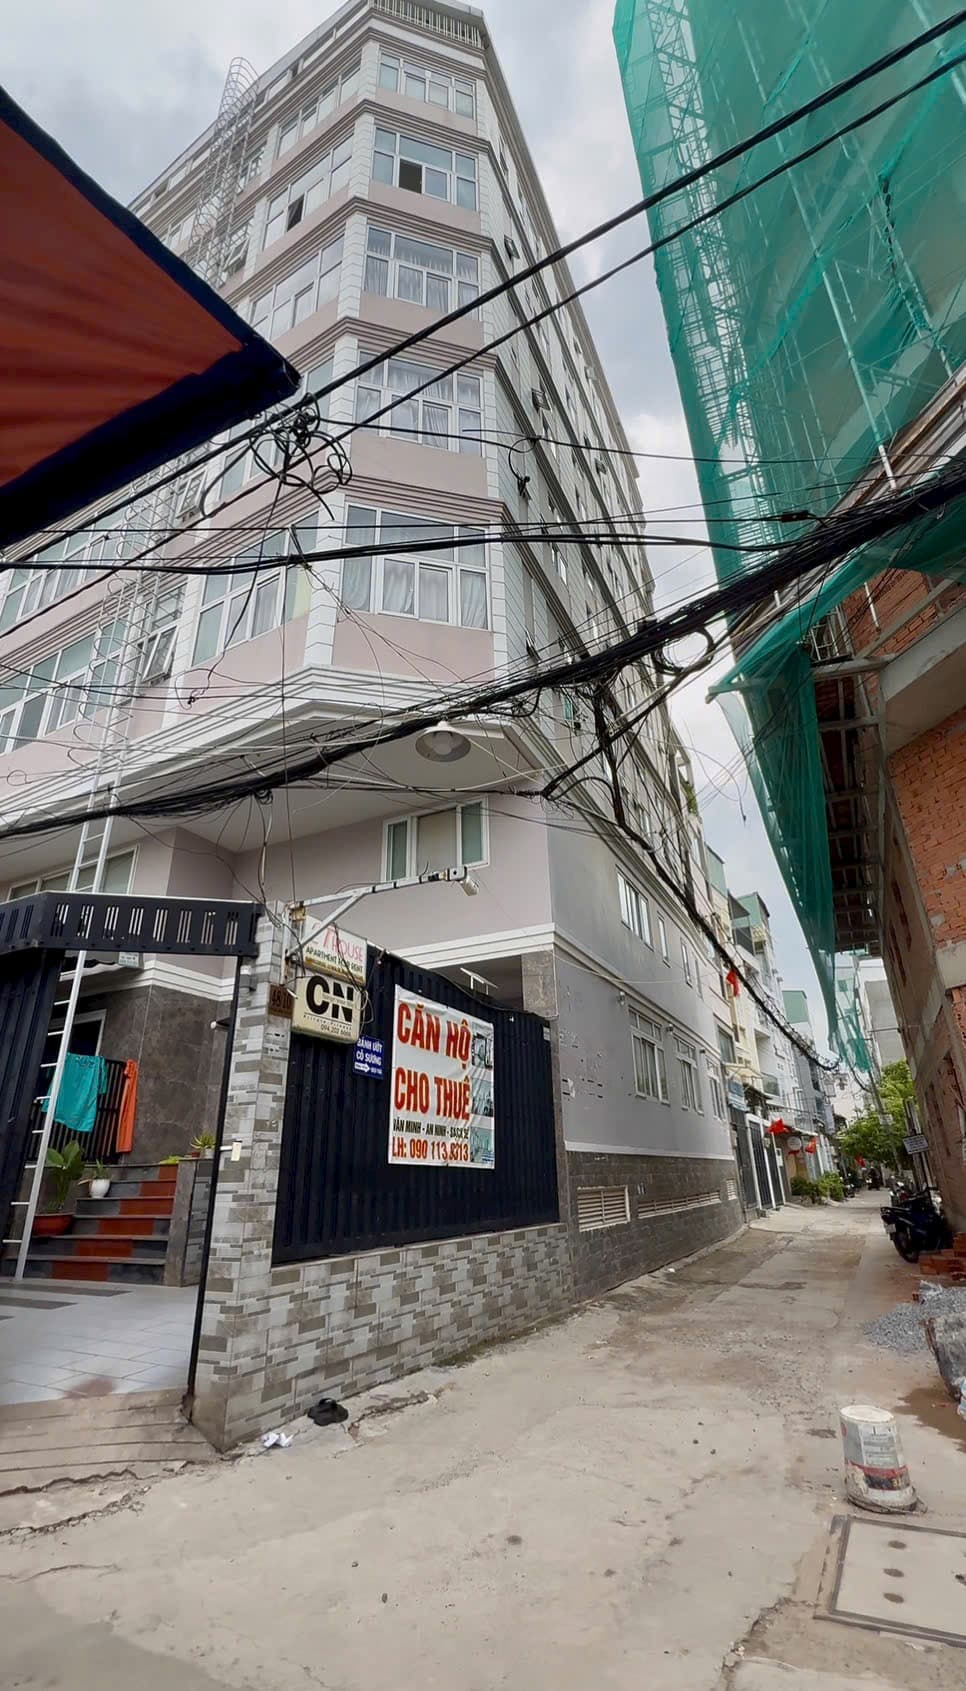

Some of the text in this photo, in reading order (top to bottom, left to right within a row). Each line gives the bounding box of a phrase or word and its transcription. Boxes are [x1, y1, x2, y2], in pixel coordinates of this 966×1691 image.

[306, 975, 354, 1023] CN
[397, 1003, 471, 1070] CĂN HỘ
[394, 1066, 471, 1120] CHO THUÊ
[392, 1136, 407, 1158] LH:
[409, 1138, 428, 1159] 090
[405, 1120, 421, 1134] MINH
[426, 1123, 433, 1136] AN
[434, 1124, 447, 1137] NINH
